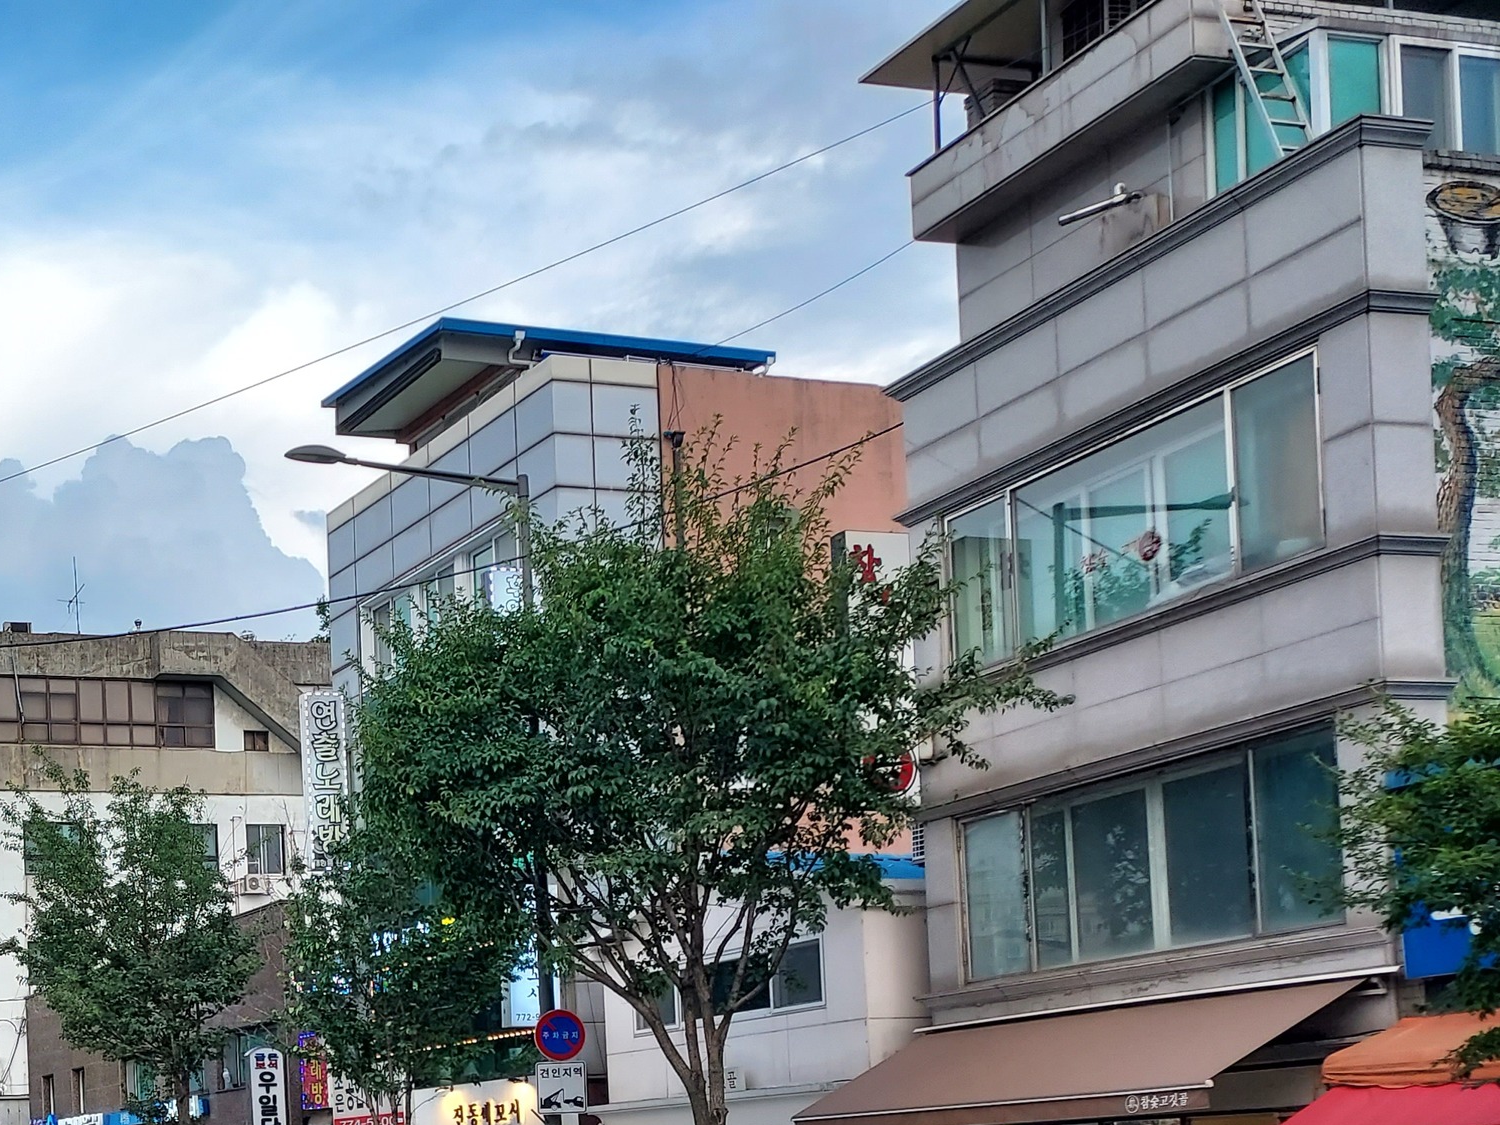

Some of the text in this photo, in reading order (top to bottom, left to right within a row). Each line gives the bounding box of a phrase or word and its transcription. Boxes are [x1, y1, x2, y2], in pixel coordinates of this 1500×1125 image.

[311, 700, 346, 854] 연출노래방
[542, 1031, 579, 1040] 주차금지
[539, 1066, 583, 1079] 견인지역
[1140, 1091, 1189, 1110] 참숯고깃골
